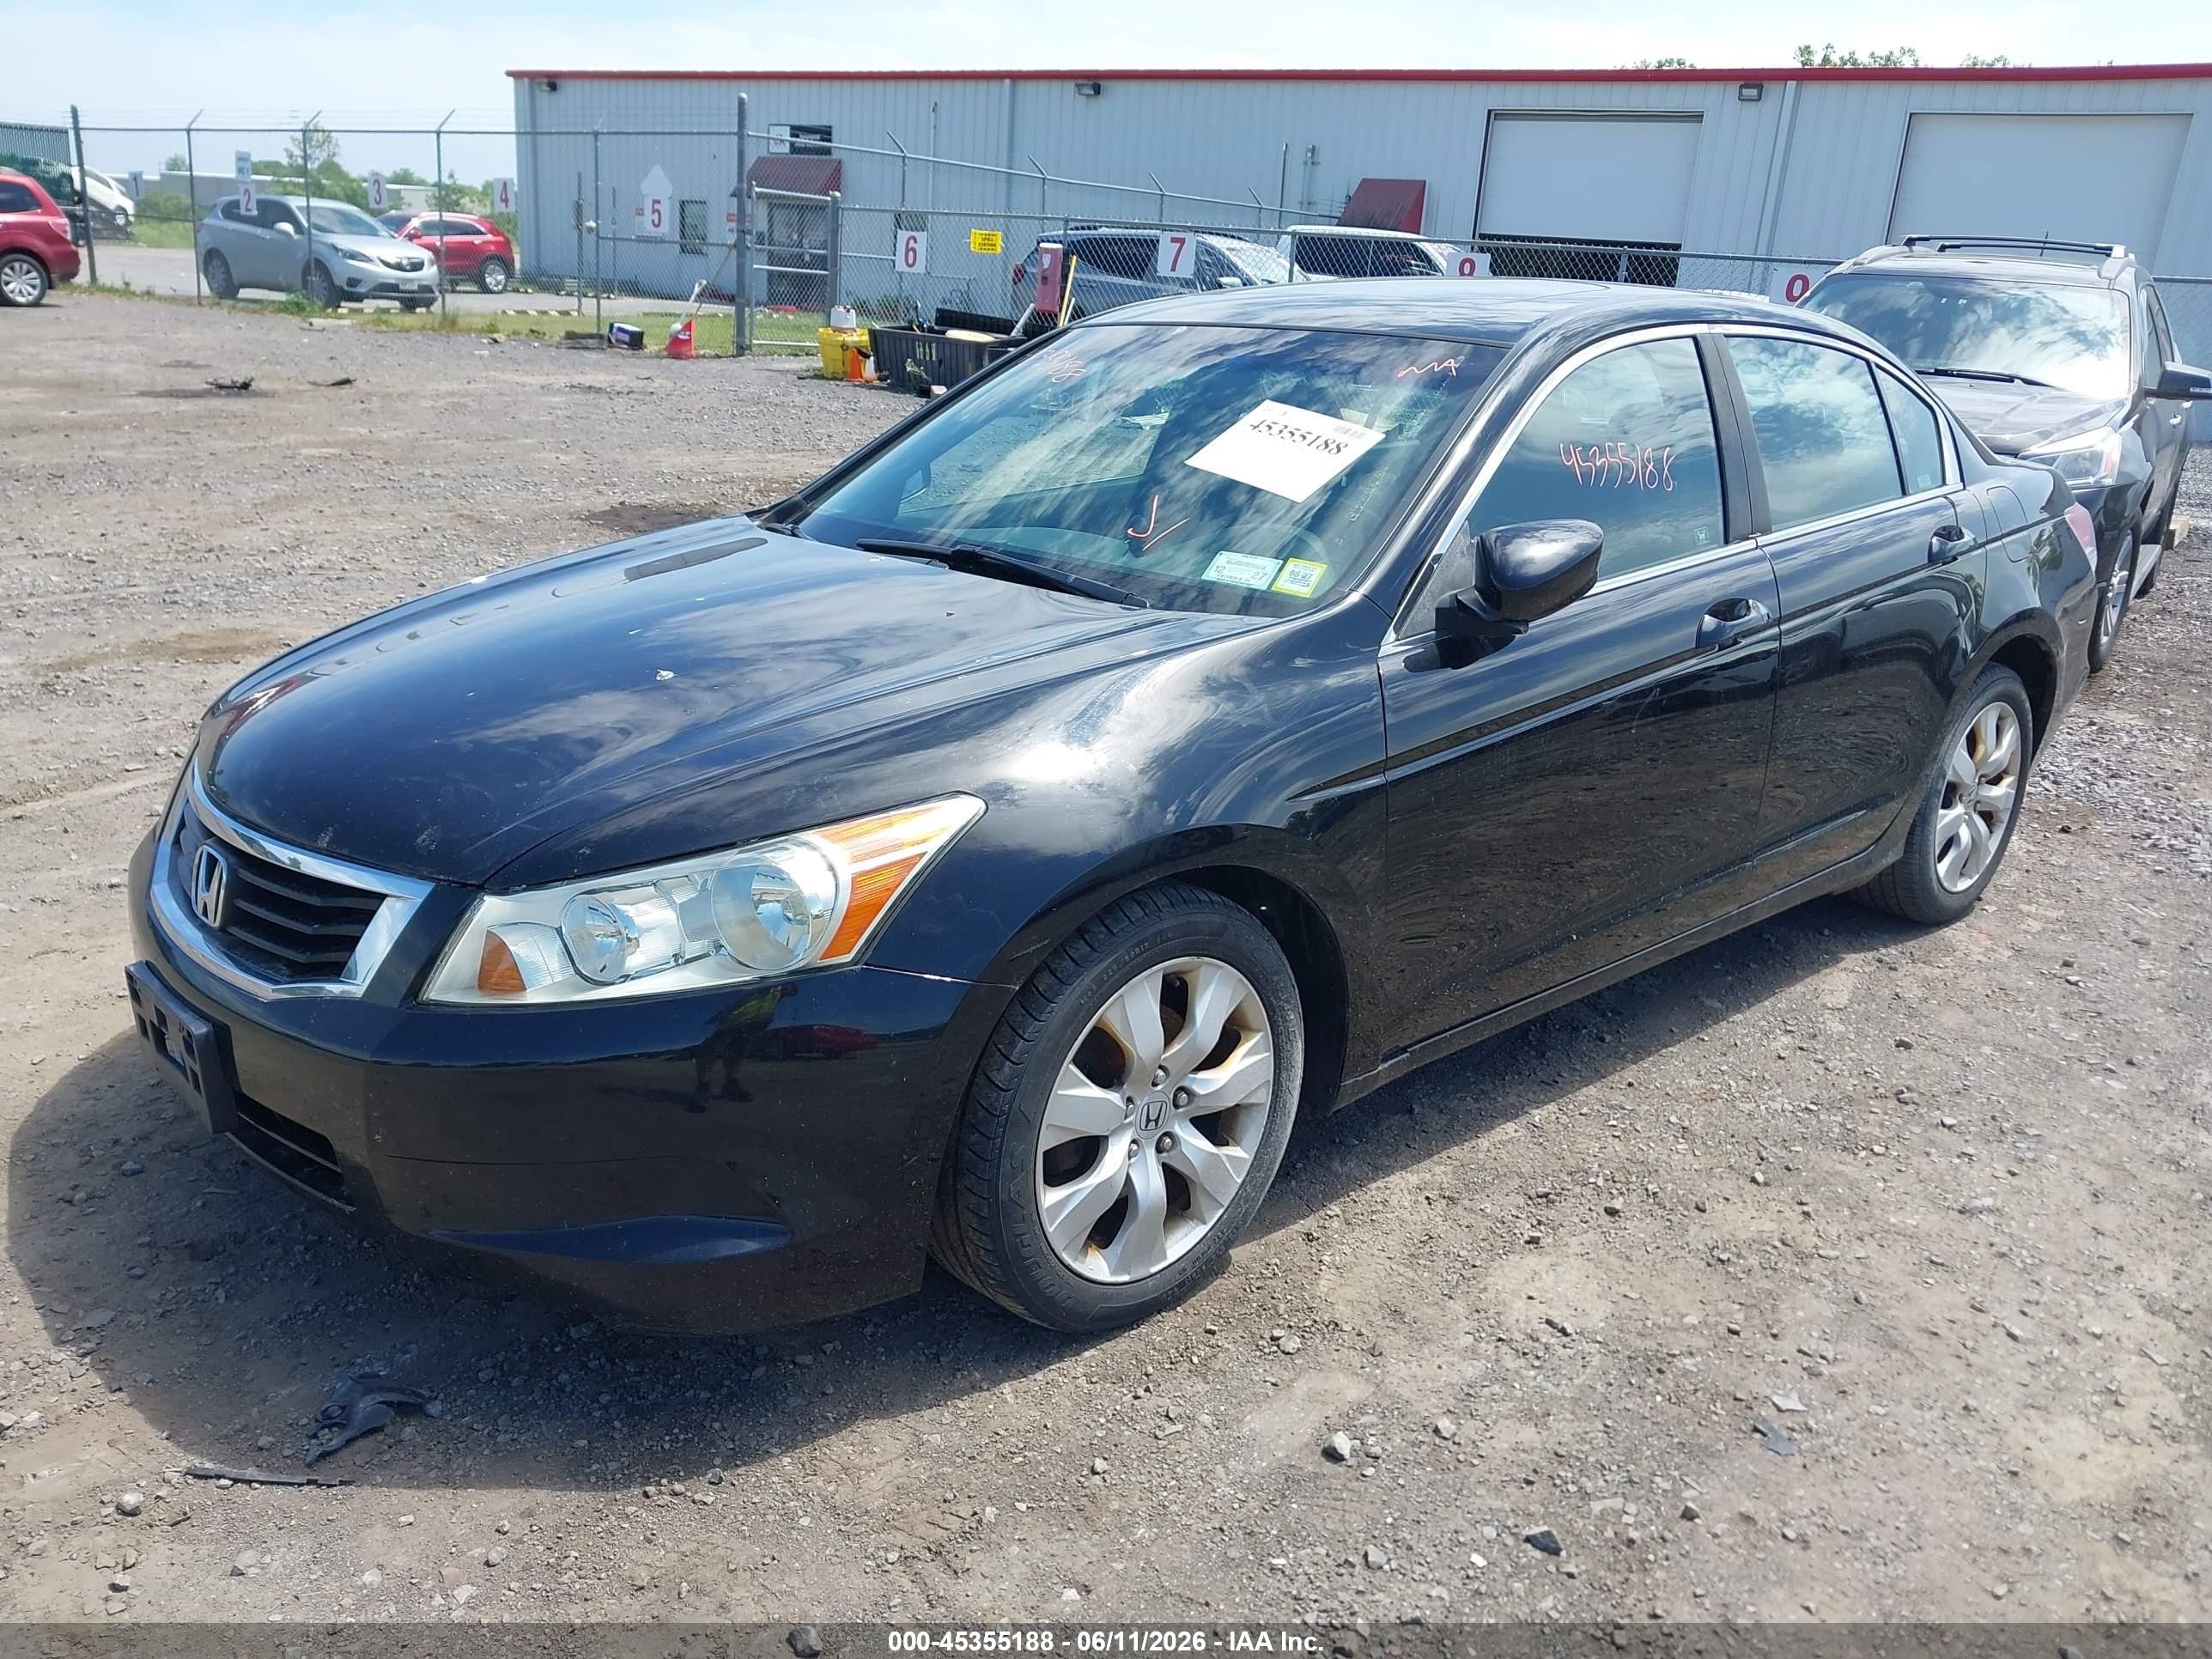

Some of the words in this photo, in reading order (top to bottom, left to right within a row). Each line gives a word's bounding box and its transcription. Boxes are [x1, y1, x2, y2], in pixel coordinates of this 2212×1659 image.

[243, 188, 252, 212] 2
[373, 179, 382, 205] 3
[500, 180, 508, 208] 4
[651, 199, 662, 228] 5
[904, 235, 918, 268] 6
[1170, 237, 1186, 272] 7
[1249, 420, 1348, 454] 45355188
[1559, 443, 1676, 491] 45355188
